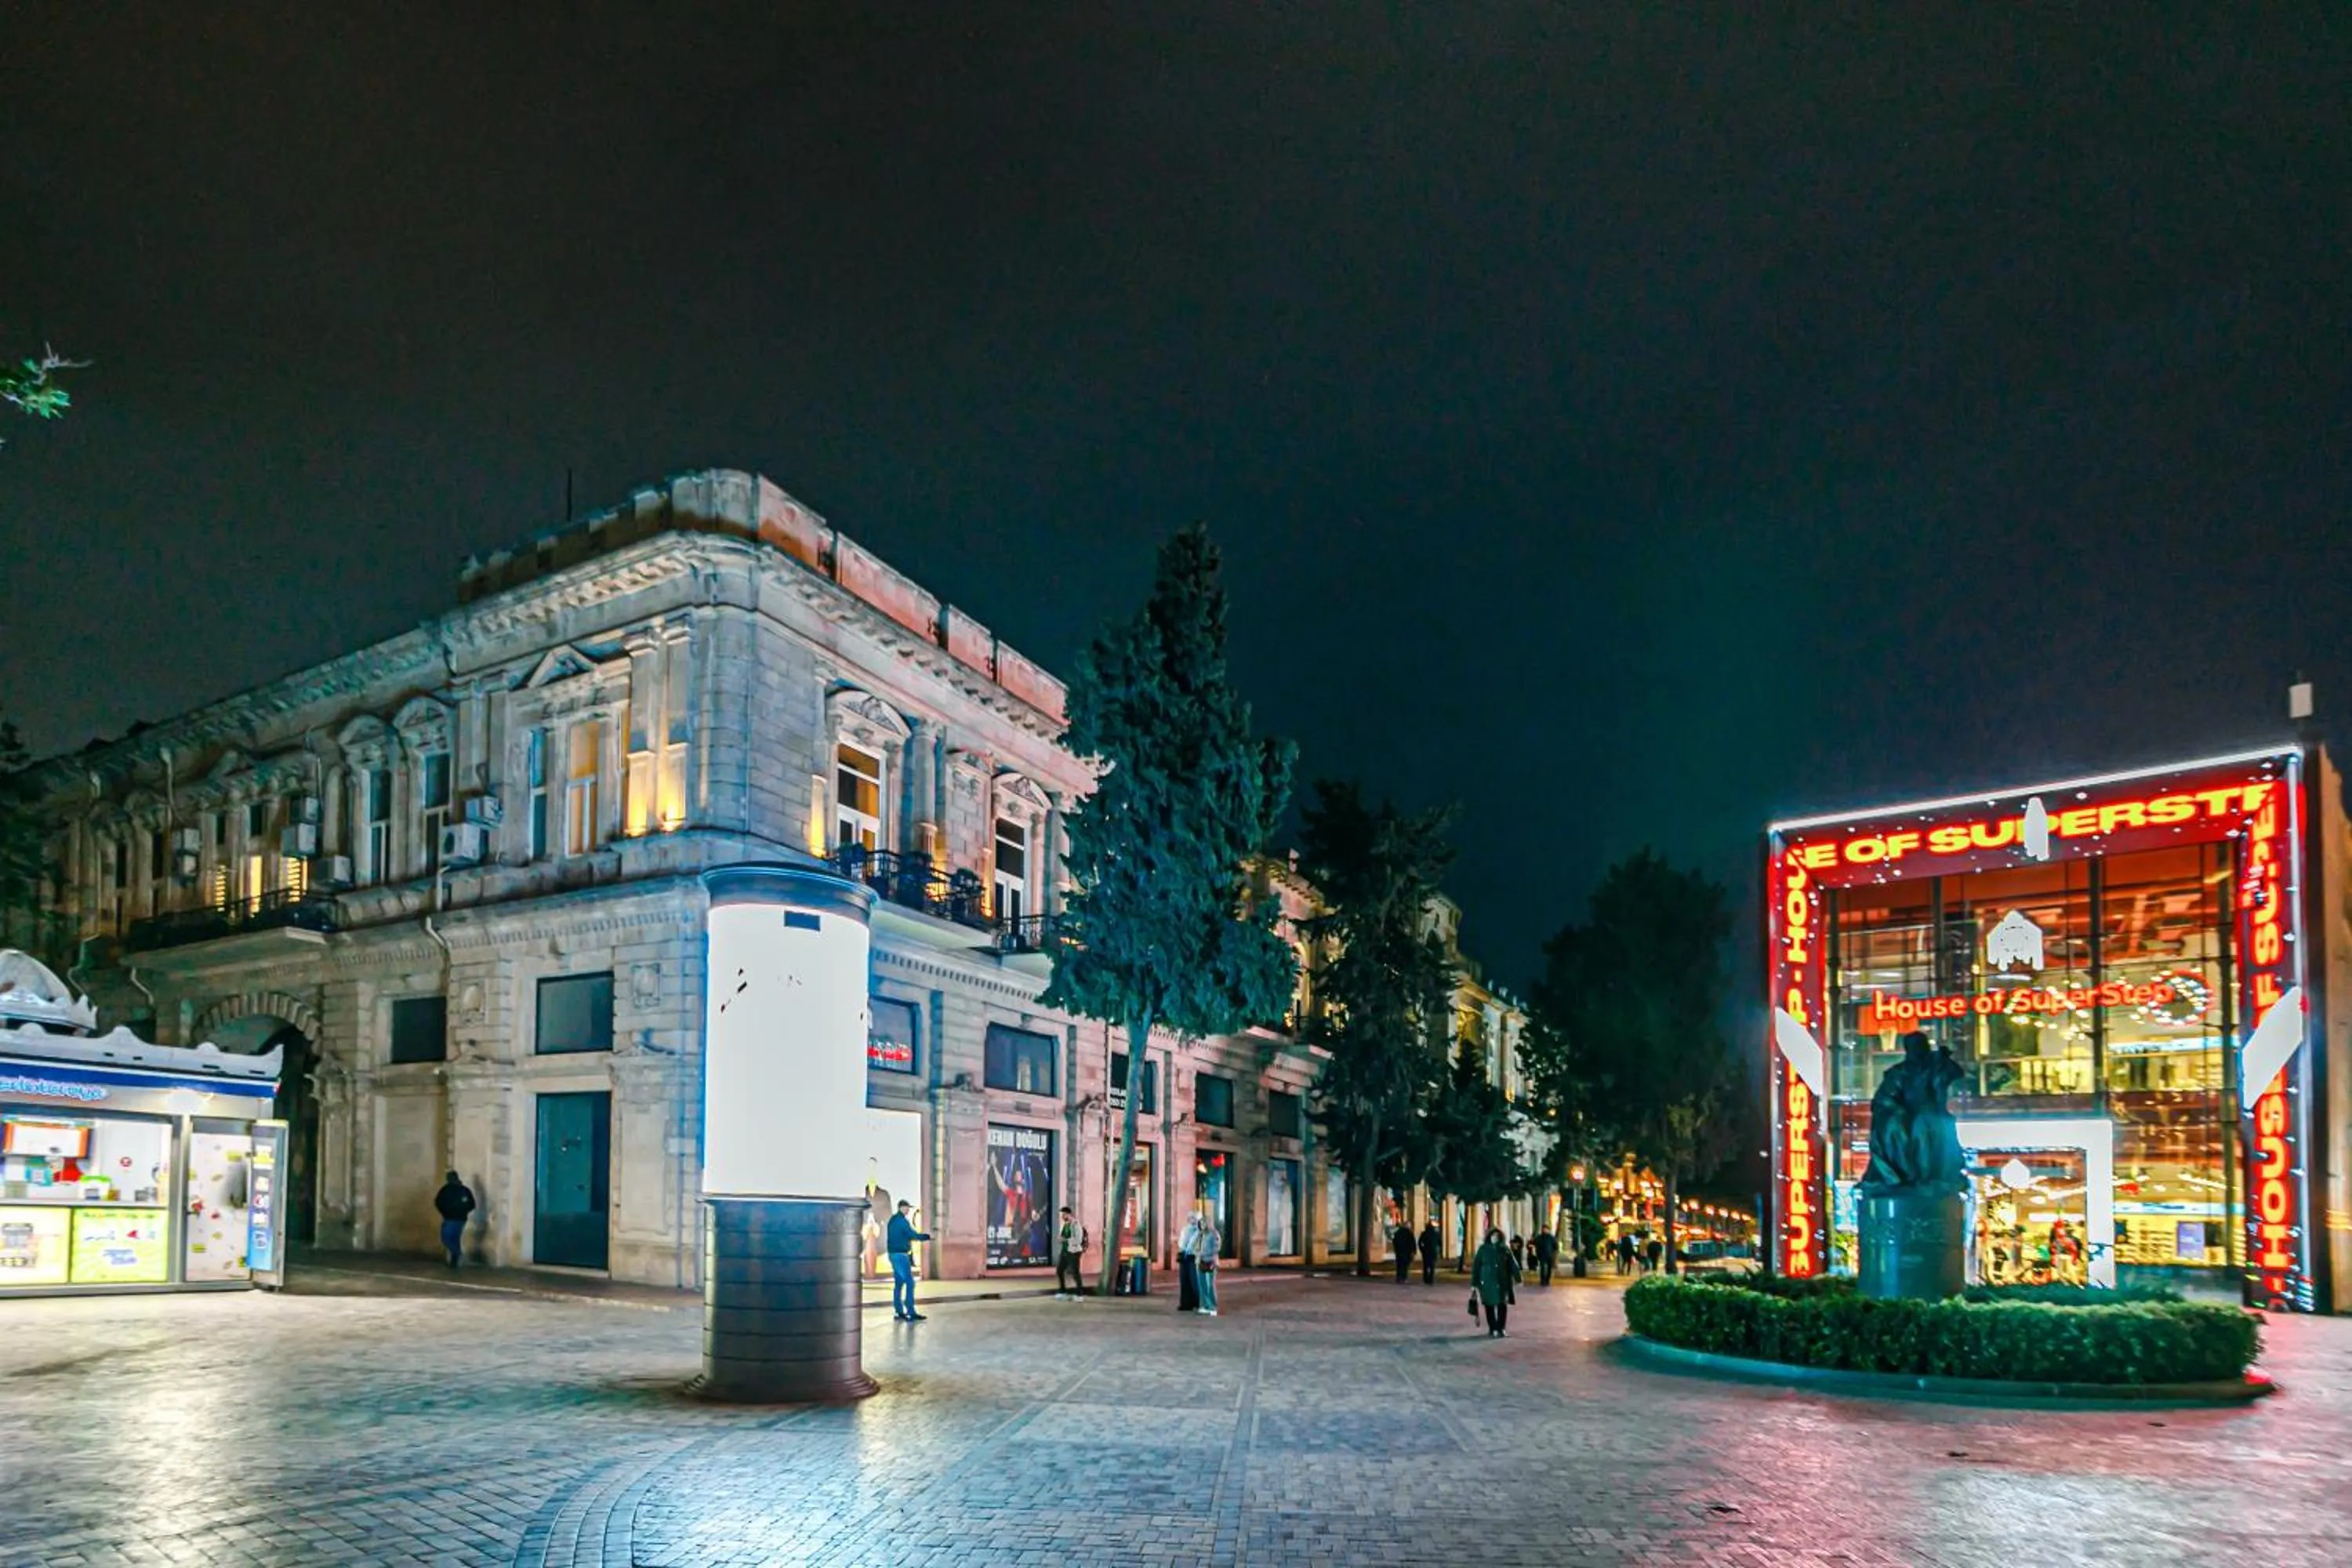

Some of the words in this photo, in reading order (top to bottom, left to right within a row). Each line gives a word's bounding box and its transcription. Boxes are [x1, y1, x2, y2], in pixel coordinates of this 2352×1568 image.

[1844, 831, 1920, 863] OF
[1875, 989, 1966, 1020] House
[1973, 992, 2007, 1014] of
